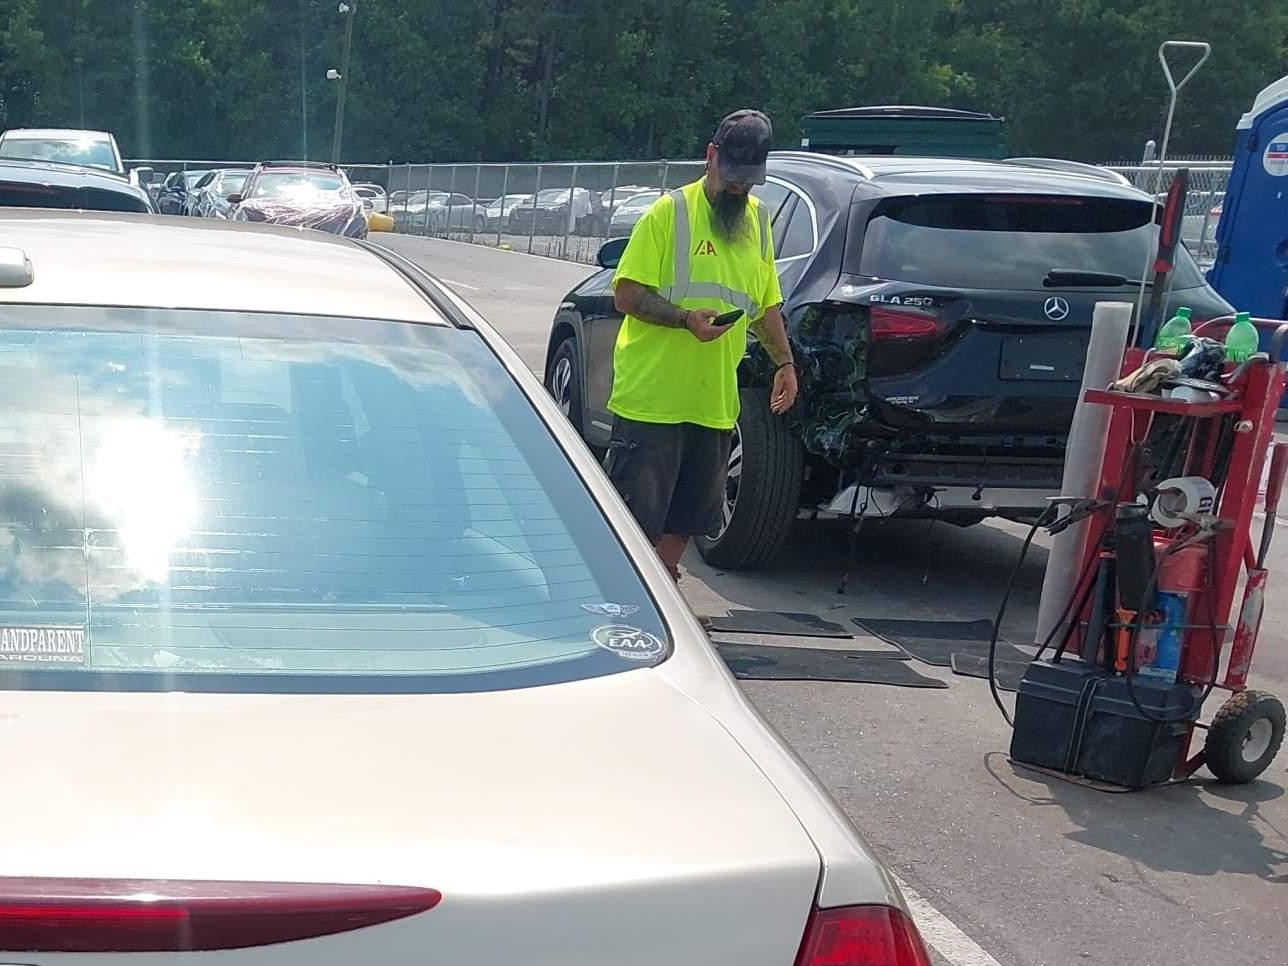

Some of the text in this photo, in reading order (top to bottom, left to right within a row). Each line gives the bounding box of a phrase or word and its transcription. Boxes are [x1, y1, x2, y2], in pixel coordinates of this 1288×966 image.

[869, 294, 934, 307] GLA 250
[608, 637, 646, 649] EAA
